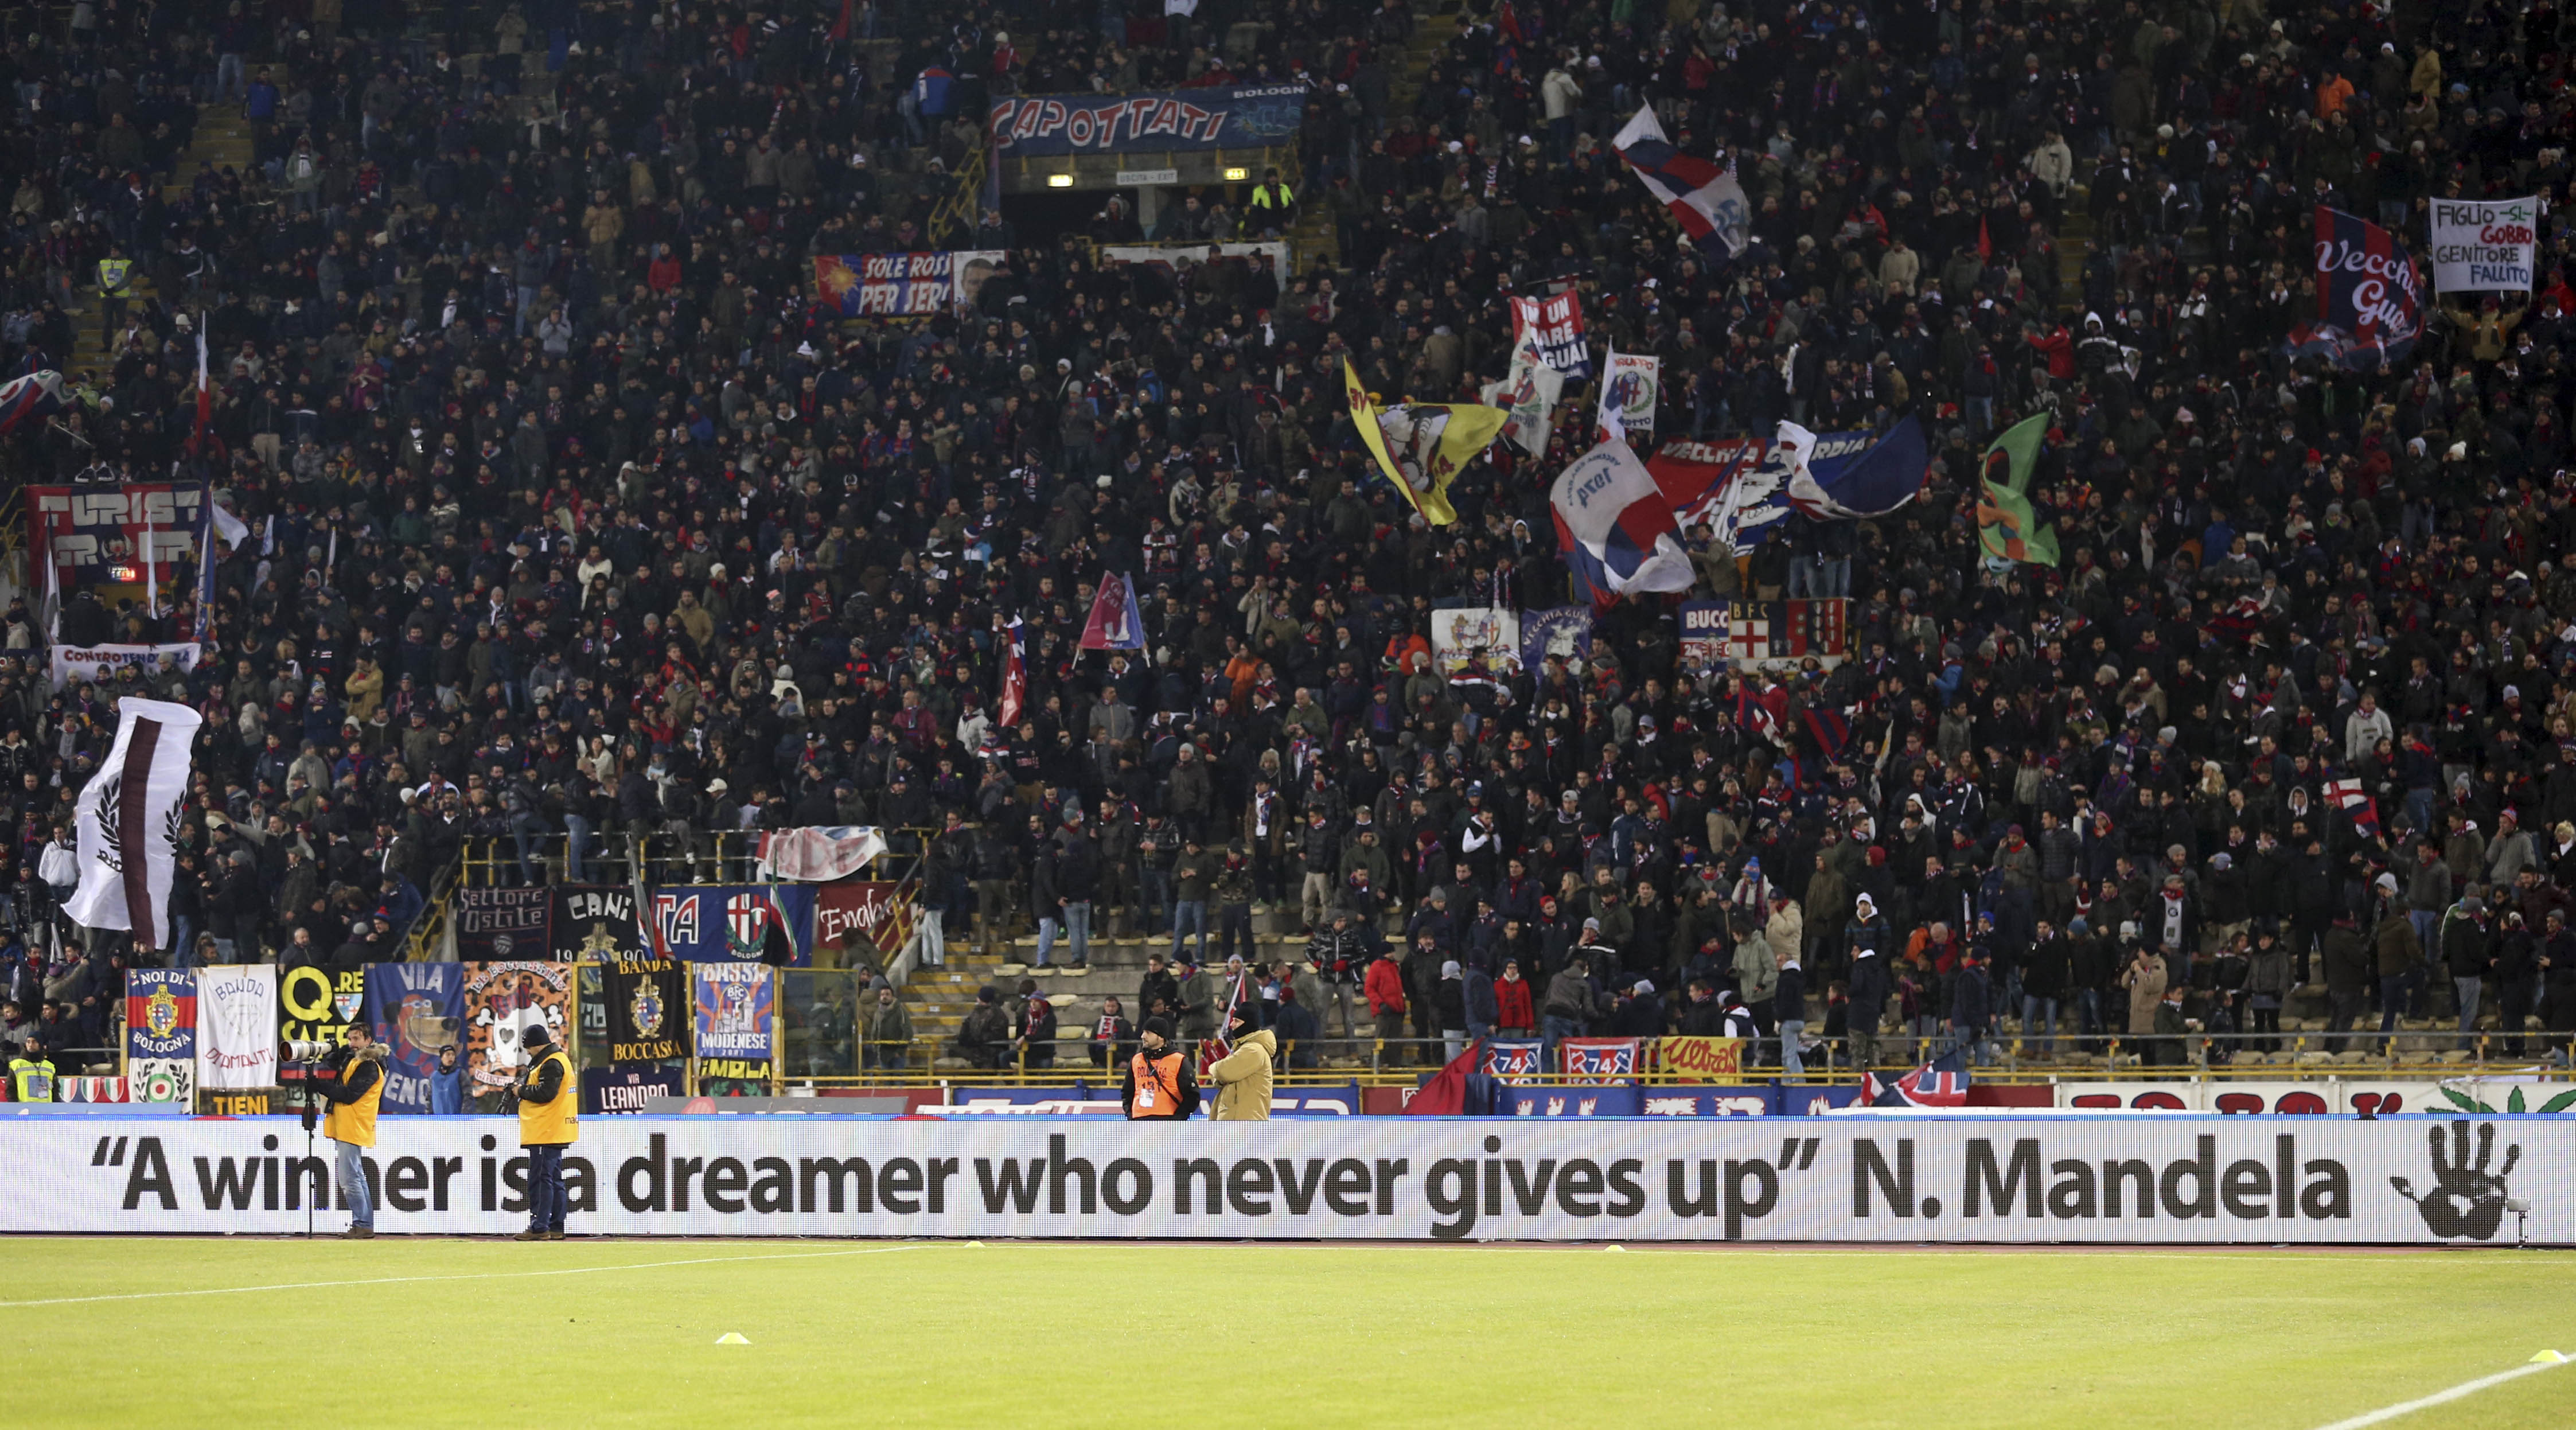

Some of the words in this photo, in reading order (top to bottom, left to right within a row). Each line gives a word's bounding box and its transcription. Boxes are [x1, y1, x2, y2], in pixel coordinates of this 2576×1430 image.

[1233, 85, 1305, 99] BOLOGN
[990, 98, 1228, 149] CAPOTTATI
[2481, 224, 2533, 245] GOBBO
[866, 256, 907, 278] SOLE
[910, 254, 951, 276] ROSS
[858, 282, 899, 314] PER
[1521, 303, 1540, 324] IN
[1547, 297, 1570, 324] UN
[1541, 341, 1588, 369] GUAI
[1764, 437, 1866, 464] GRDIA
[1565, 609, 1596, 629] GUAR
[64, 648, 190, 664] CONTROTENDZA
[618, 959, 673, 975] BANDA
[702, 962, 768, 983] BASSA
[140, 971, 166, 985] NOI
[169, 971, 185, 985] DI
[397, 963, 443, 993] VIA
[215, 978, 264, 1001] BANDA
[727, 984, 745, 998] BFC
[132, 1031, 192, 1053] BOLOGNA
[613, 1039, 683, 1061] BOCCASSA
[701, 1032, 767, 1050] MODENESE
[1500, 1057, 1522, 1072] 74
[1588, 1058, 1612, 1073] 74
[627, 1073, 640, 1084] VIA
[213, 1095, 268, 1115] TIENI
[601, 1083, 669, 1110] LEANDRO
[481, 1135, 531, 1213] is
[617, 1133, 959, 1214] dreamer
[974, 1134, 1153, 1215] who
[1175, 1157, 1408, 1217] never
[1425, 1135, 1645, 1238] gives
[1853, 1138, 1940, 1218] N.
[1963, 1134, 2352, 1219] Mandela
